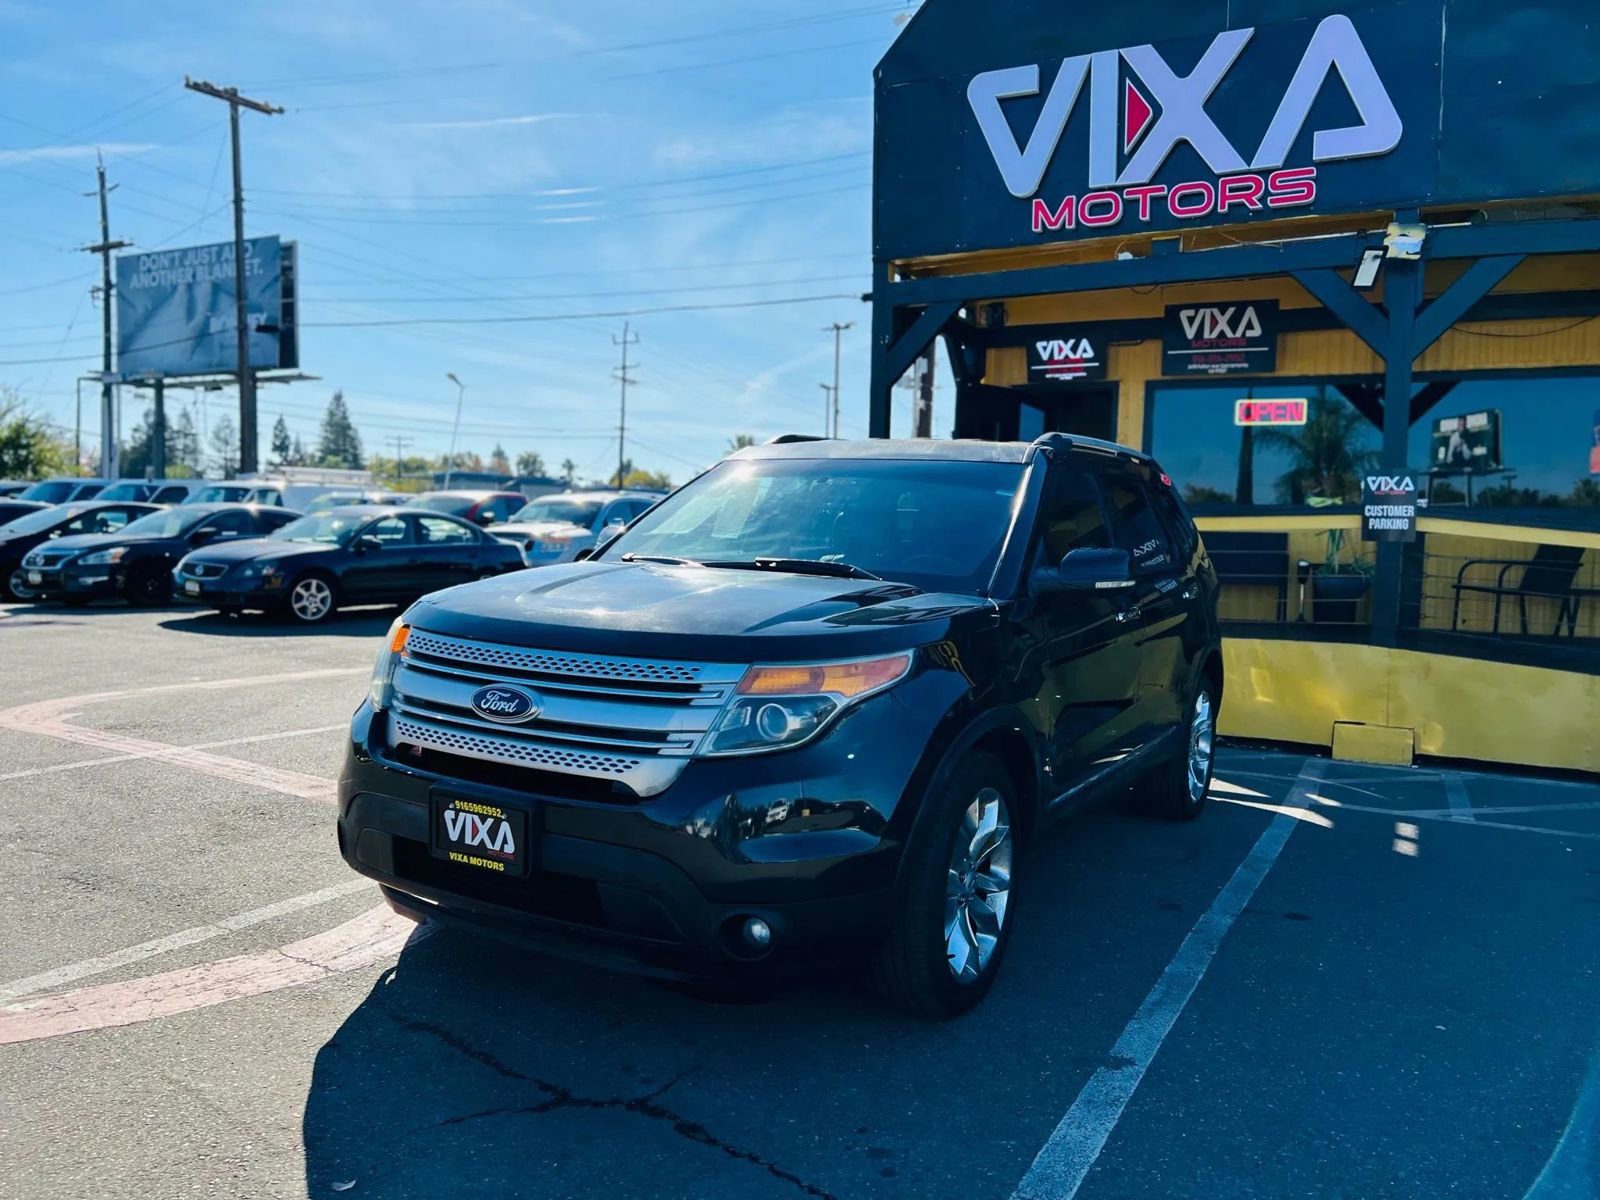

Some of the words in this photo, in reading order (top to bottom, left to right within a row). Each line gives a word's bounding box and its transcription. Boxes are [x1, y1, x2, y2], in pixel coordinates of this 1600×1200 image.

[967, 14, 1403, 198] VIXA
[1032, 167, 1316, 232] MOTORS
[139, 250, 182, 271] DON'T
[184, 246, 219, 266] JUST
[130, 267, 194, 289] ANOTHER
[195, 258, 264, 283] BLANET.
[1179, 306, 1262, 340] VIXA
[1035, 338, 1095, 361] VIXA
[1238, 401, 1304, 423] OPEN
[1366, 475, 1415, 492] VIXA
[1364, 504, 1415, 517] CUSTOMER
[1368, 517, 1410, 530] PARKING
[480, 690, 519, 713] Ford
[454, 800, 502, 818] 9165962952
[443, 809, 515, 854] VIXA
[449, 851, 468, 865] VIXA
[469, 856, 505, 871] MOTORS
